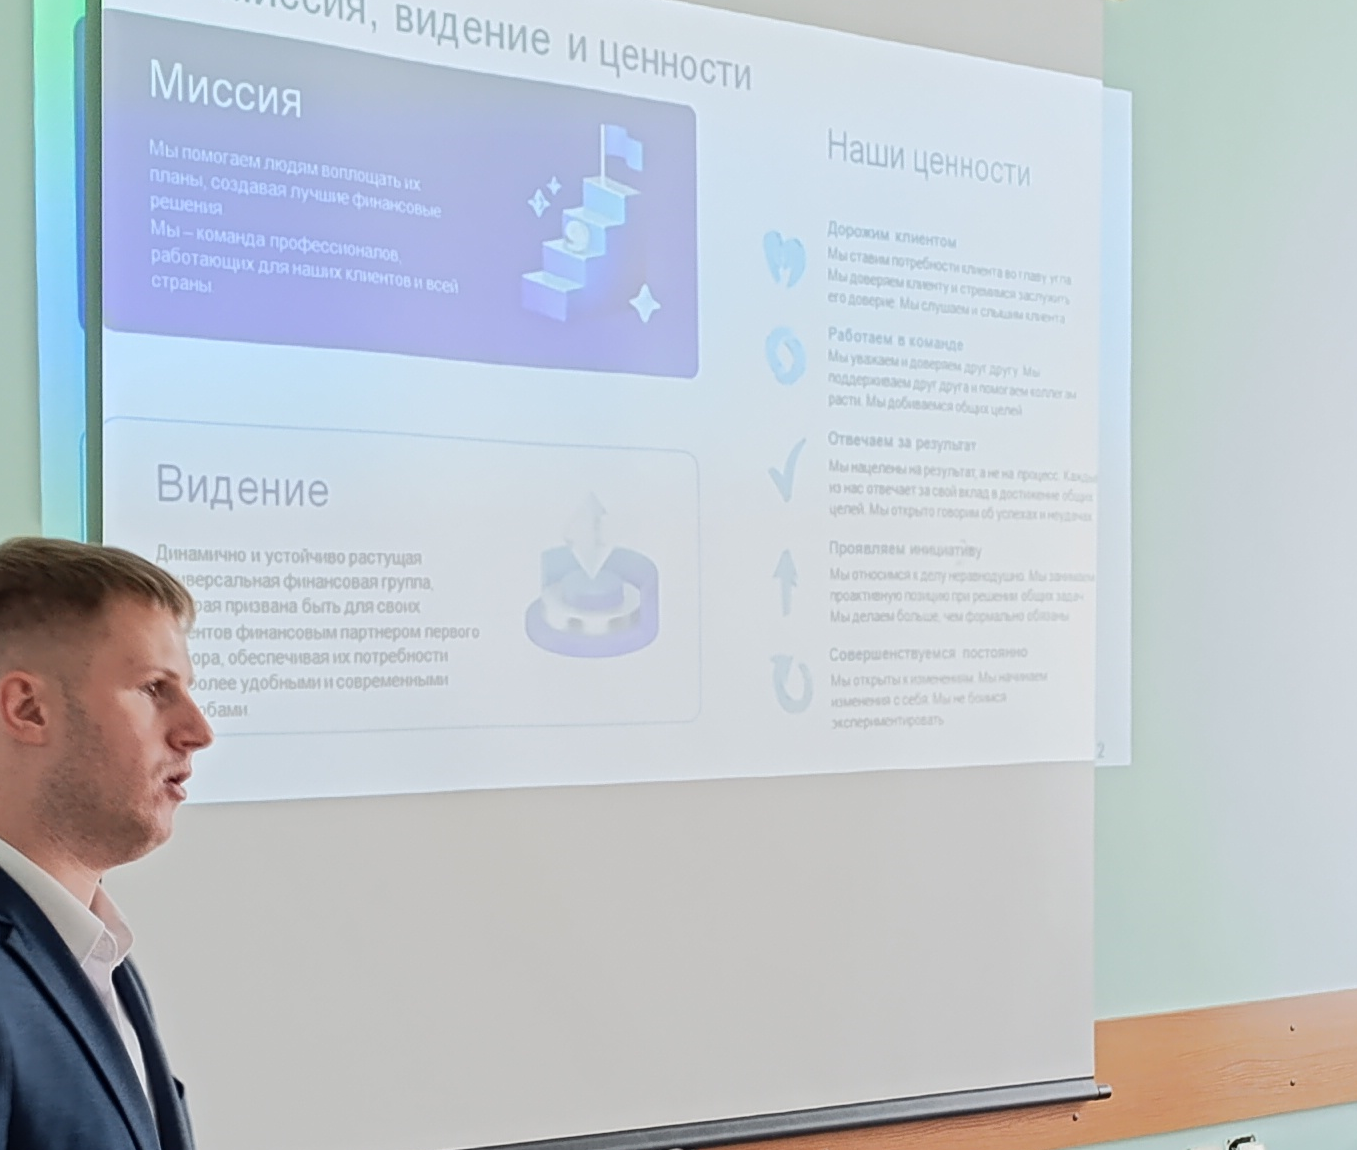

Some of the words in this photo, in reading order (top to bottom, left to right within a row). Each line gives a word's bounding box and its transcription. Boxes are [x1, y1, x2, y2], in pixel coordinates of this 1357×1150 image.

[395, 4, 551, 56] видение
[568, 31, 587, 63] и
[599, 38, 753, 92] ценности
[149, 58, 303, 119] Миссия
[149, 138, 180, 157] Мы
[264, 158, 319, 175] людям
[322, 165, 402, 188] воплощать
[404, 179, 422, 190] их
[827, 127, 906, 171] Наши
[913, 148, 1032, 187] ценности
[149, 169, 207, 189] планы,
[211, 177, 288, 196] создавая
[290, 186, 350, 205] лучшие
[352, 193, 443, 218] финансовые
[150, 218, 181, 237] Мы
[196, 229, 266, 247] команда
[270, 236, 403, 264] профессионалов,
[151, 248, 255, 273] работающих
[258, 261, 290, 274] для
[293, 264, 343, 279] наших
[345, 270, 412, 287] клиентов
[414, 278, 424, 288] и
[426, 279, 460, 293] всей
[156, 463, 330, 511] Видение
[156, 544, 246, 562] Динамично
[251, 551, 262, 562] и
[265, 549, 345, 566] устойчиво
[349, 553, 423, 567] растущая
[181, 574, 281, 591] версальная
[283, 574, 379, 591] финансовая
[381, 577, 434, 592] группа,
[226, 601, 298, 616] призвана
[302, 597, 341, 613] быть
[344, 601, 375, 615] для
[377, 601, 422, 613] своих
[187, 627, 233, 640] ентов
[236, 625, 338, 642] финансовым
[340, 628, 422, 642] партнером
[425, 627, 480, 641] первого
[192, 653, 225, 667] ора,
[228, 649, 330, 665] обеспечивая
[333, 653, 351, 663] их
[354, 648, 449, 665] потребности
[241, 674, 322, 694] удобными
[324, 678, 335, 688] и
[337, 676, 449, 691] современными
